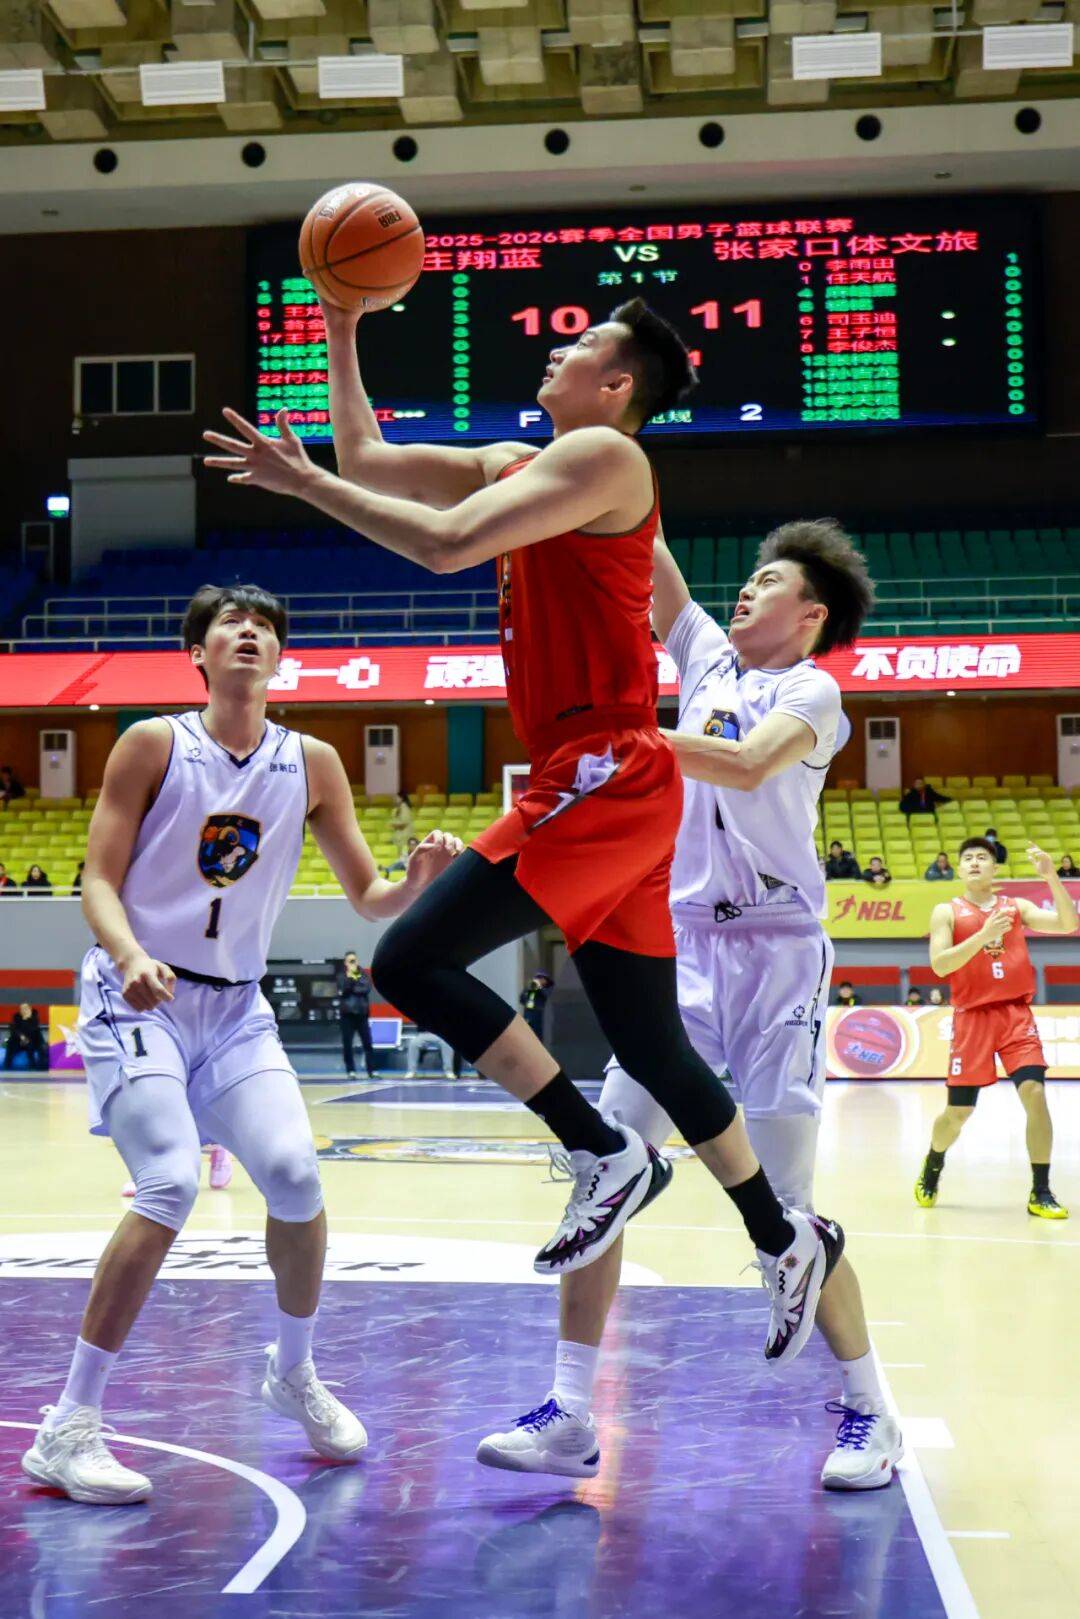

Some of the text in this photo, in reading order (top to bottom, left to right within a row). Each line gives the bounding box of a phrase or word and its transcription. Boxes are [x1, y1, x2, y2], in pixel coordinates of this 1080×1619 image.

[614, 243, 660, 262] VS
[713, 231, 979, 261] 张家口体文旅
[511, 306, 589, 336] 10
[690, 299, 762, 330] 11
[740, 404, 763, 421] 2
[851, 644, 1021, 680] 不负使命
[205, 898, 222, 938] 1
[857, 901, 906, 920] NBL
[992, 962, 1005, 979] 6
[131, 1027, 147, 1057] 1
[951, 1058, 962, 1075] 6
